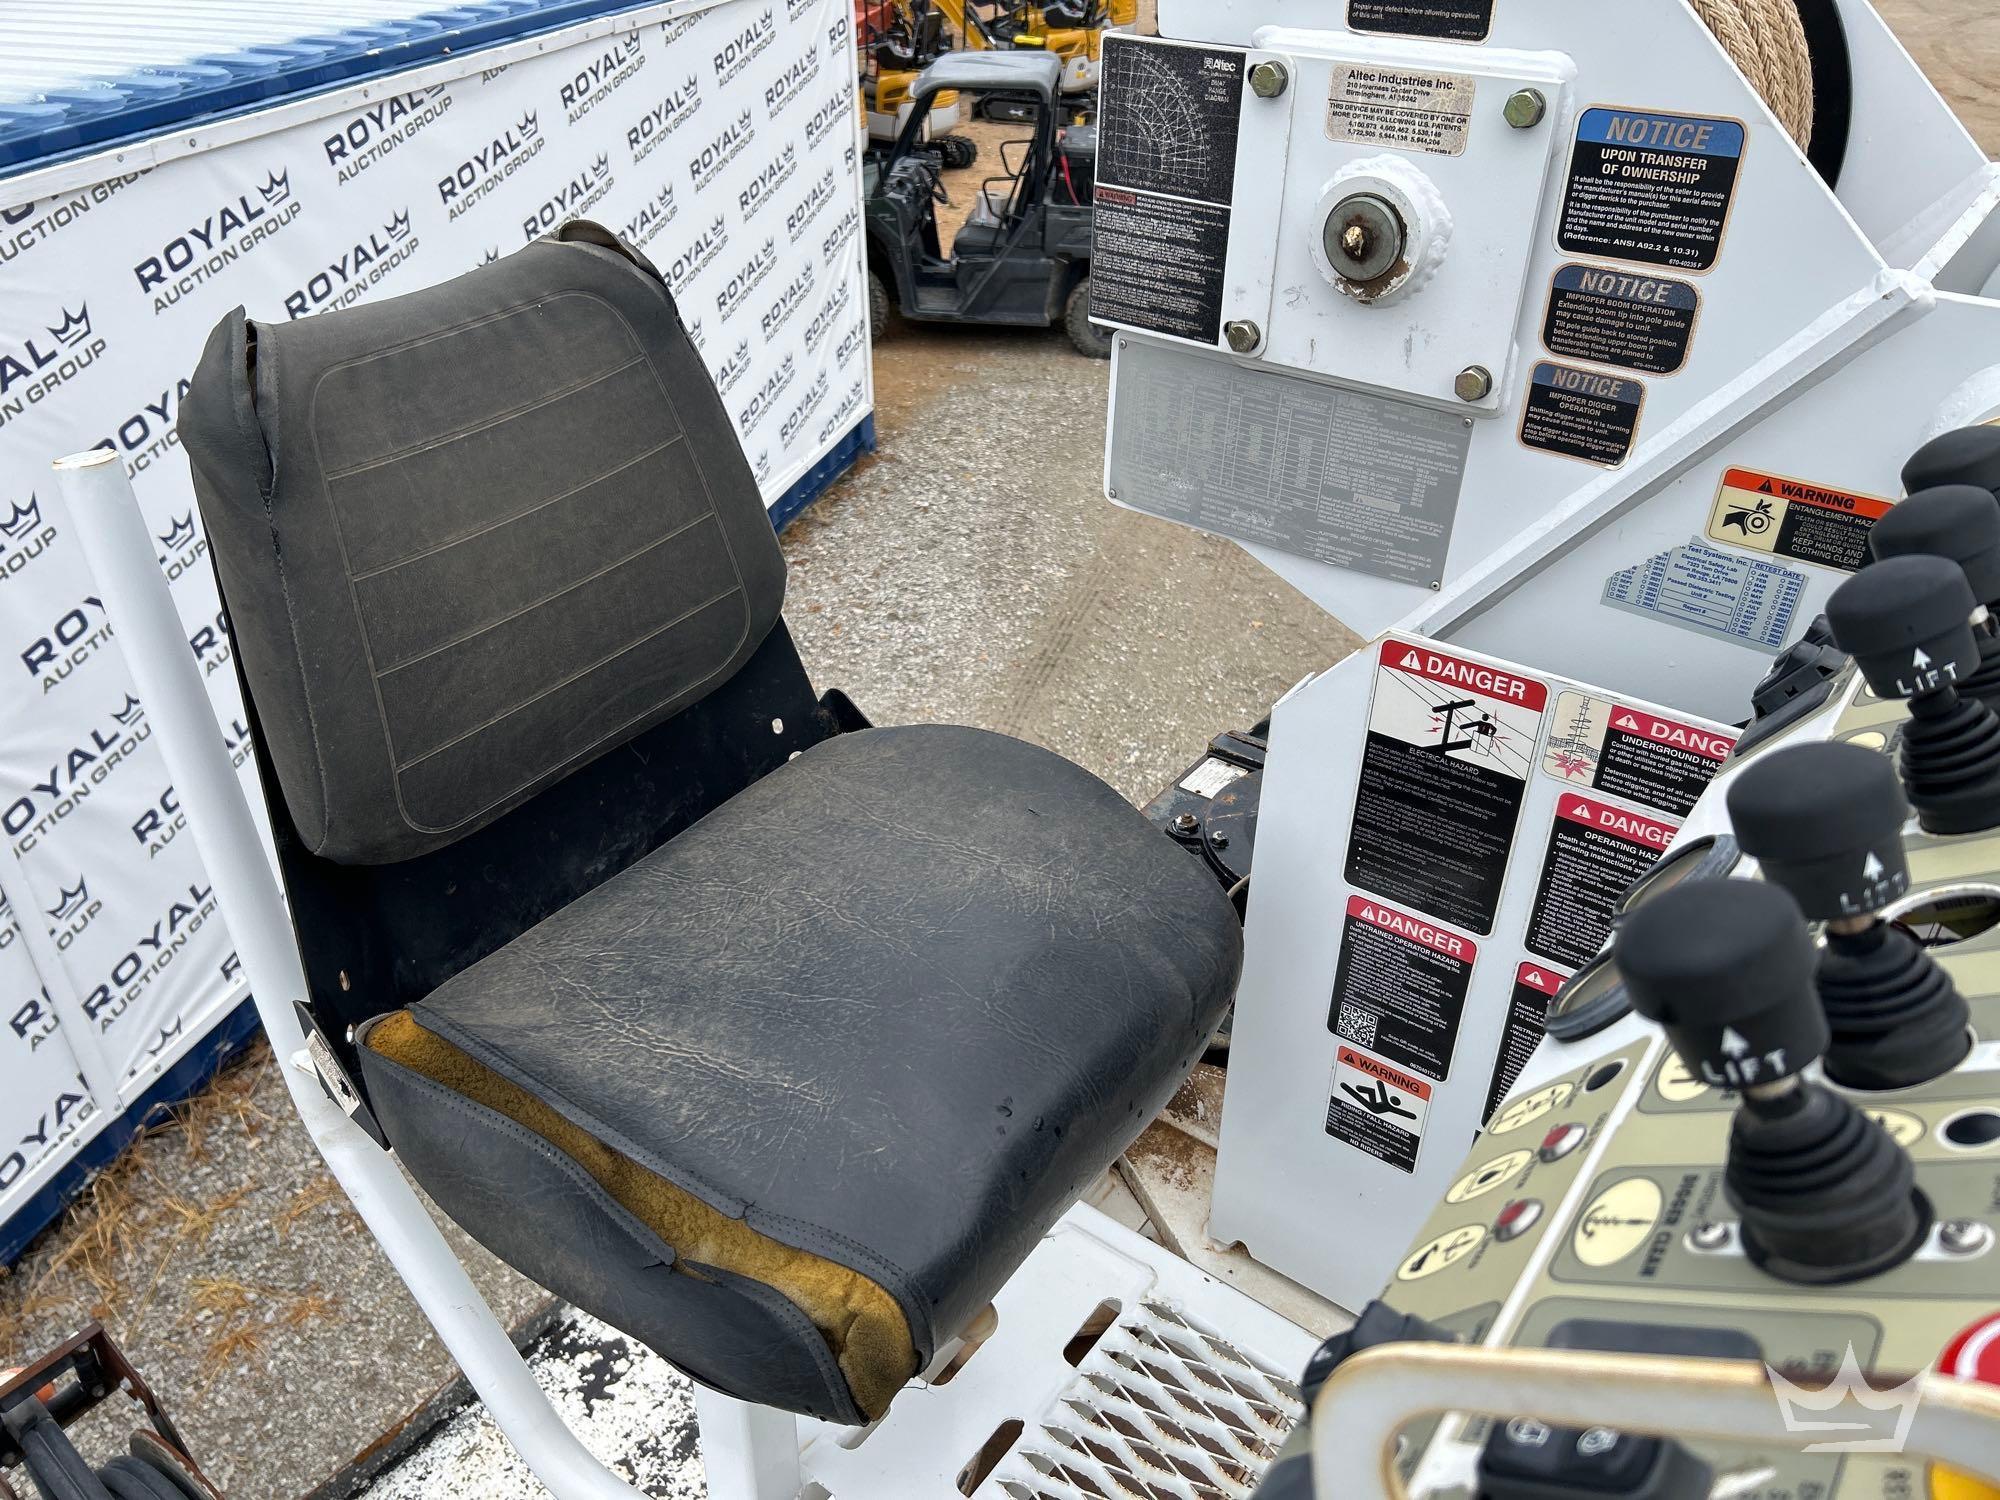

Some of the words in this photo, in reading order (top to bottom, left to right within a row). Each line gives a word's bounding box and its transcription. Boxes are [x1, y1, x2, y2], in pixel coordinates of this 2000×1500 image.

[712, 26, 762, 76] ROYAL
[718, 54, 752, 90] AUCTION
[750, 30, 778, 60] GROUP
[1214, 58, 1236, 72] Altec
[560, 44, 628, 110] ROYAL
[568, 82, 613, 127] AUCTION
[612, 54, 646, 90] GROUP
[764, 59, 810, 108] ROYAL
[1348, 69, 1375, 81] Altec
[1378, 73, 1432, 87] Industries
[1435, 78, 1455, 90] Inc.
[323, 90, 426, 166] ROYAL
[627, 90, 686, 152] ROYAL
[633, 125, 674, 166] AUCTION
[672, 96, 702, 132] GROUP
[1332, 110, 1350, 118] MORE
[1376, 115, 1415, 126] FOLLOWING
[1417, 120, 1430, 128] U.S.
[1431, 122, 1461, 131] PATENTS
[1344, 104, 1368, 112] DEVICE
[1396, 110, 1428, 120] COVERED
[1440, 115, 1456, 123] ONE
[337, 131, 403, 186] AUCTION
[404, 96, 453, 138] GROUP
[1606, 117, 1712, 149] NOTICE
[438, 128, 521, 206] ROYAL
[688, 121, 743, 182] ROYAL
[694, 157, 730, 195] AUCTION
[728, 129, 756, 162] GROUP
[1601, 148, 1636, 162] UPON
[1640, 152, 1707, 170] TRANSFER
[448, 170, 504, 223] AUCTION
[504, 137, 546, 177] GROUP
[738, 158, 785, 212] ROYAL
[1602, 163, 1619, 174] OF
[1622, 165, 1699, 183] OWNERSHIP
[1614, 181, 1655, 193] responsibility
[1700, 191, 1724, 201] provide
[522, 172, 596, 242] ROYAL
[578, 177, 615, 216] GROUP
[0, 194, 91, 263] UCTION
[134, 195, 265, 294] ROYAL
[1563, 232, 1610, 243] (Reference:
[1613, 238, 1635, 247] ANSI
[1636, 242, 1661, 251] A92.2
[1673, 247, 1698, 257] 10.31)
[154, 243, 240, 315] AUCTION
[242, 201, 303, 252] GROUP
[370, 237, 420, 286] GROUP
[284, 233, 390, 320] ROYAL
[716, 256, 764, 312] ROYAL
[1580, 272, 1671, 302] NOTICE
[762, 278, 804, 334] ROYAL
[1557, 300, 1594, 314] Extending
[1595, 306, 1616, 316] boom
[1617, 310, 1628, 319] tip
[1629, 312, 1644, 321] into
[1645, 316, 1662, 324] pole
[1663, 319, 1685, 328] guide
[1566, 292, 1605, 304] IMPROPER
[1607, 299, 1630, 308] BOOM
[1632, 303, 1675, 316] OPERATION
[26, 338, 107, 406] GROUP
[1552, 369, 1622, 397] NOTICE
[740, 370, 785, 430] ROYAL
[1549, 392, 1586, 405] IMPROPER
[1587, 400, 1616, 411] DIGGER
[1559, 401, 1600, 416] OPERATION
[1781, 484, 1855, 509] WARNING
[1789, 503, 1853, 522] ENTANGLEMENT
[1854, 518, 1876, 528] HAZA
[1681, 553, 1707, 564] Electrical
[1707, 560, 1726, 570] Safety
[1688, 546, 1701, 554] Test
[1703, 550, 1736, 562] Systems,
[1791, 544, 1831, 559] CLOTHING
[1833, 554, 1859, 565] CLEAR
[1792, 536, 1813, 546] KEEP
[1814, 541, 1843, 554] HANDS
[1844, 549, 1863, 558] AND
[1688, 582, 1713, 594] Dielectric
[1755, 563, 1781, 573] RETEST
[1782, 570, 1800, 579] DATE
[1427, 656, 1525, 699] DANGER
[1896, 662, 1958, 696] LIFT
[90, 722, 152, 785] GROU
[1611, 740, 1635, 752] Contact
[1649, 752, 1670, 763] buried
[1622, 735, 1699, 763] UNDERGROUND
[1701, 758, 1722, 771] HAZ
[1651, 722, 1729, 757] DANG
[1409, 747, 1448, 766] ELECTRICAL
[1450, 761, 1479, 775] HAZARD
[1640, 764, 1663, 775] serious
[1664, 771, 1683, 782] injury.
[0, 728, 120, 836] OYAL
[1558, 832, 1578, 844] Death
[1588, 844, 1615, 856] serious
[1585, 831, 1636, 854] OPERATING
[1638, 849, 1658, 861] HAZ
[1600, 811, 1675, 847] DANGE
[1355, 921, 1393, 940] UNTRAINED
[1394, 936, 1430, 955] OPERATOR
[1431, 952, 1460, 967] HAZARD
[1377, 910, 1461, 954] DANGER
[82, 884, 212, 1022] ROYAL
[100, 932, 188, 1035] AUCTION
[1359, 1058, 1419, 1093] WARNING
[1702, 1048, 1788, 1085] LIFT
[1341, 1102, 1362, 1115] RIDING
[1383, 1122, 1409, 1137] HAZARD
[1349, 1138, 1359, 1146] NO
[1360, 1143, 1383, 1157] RIDERS
